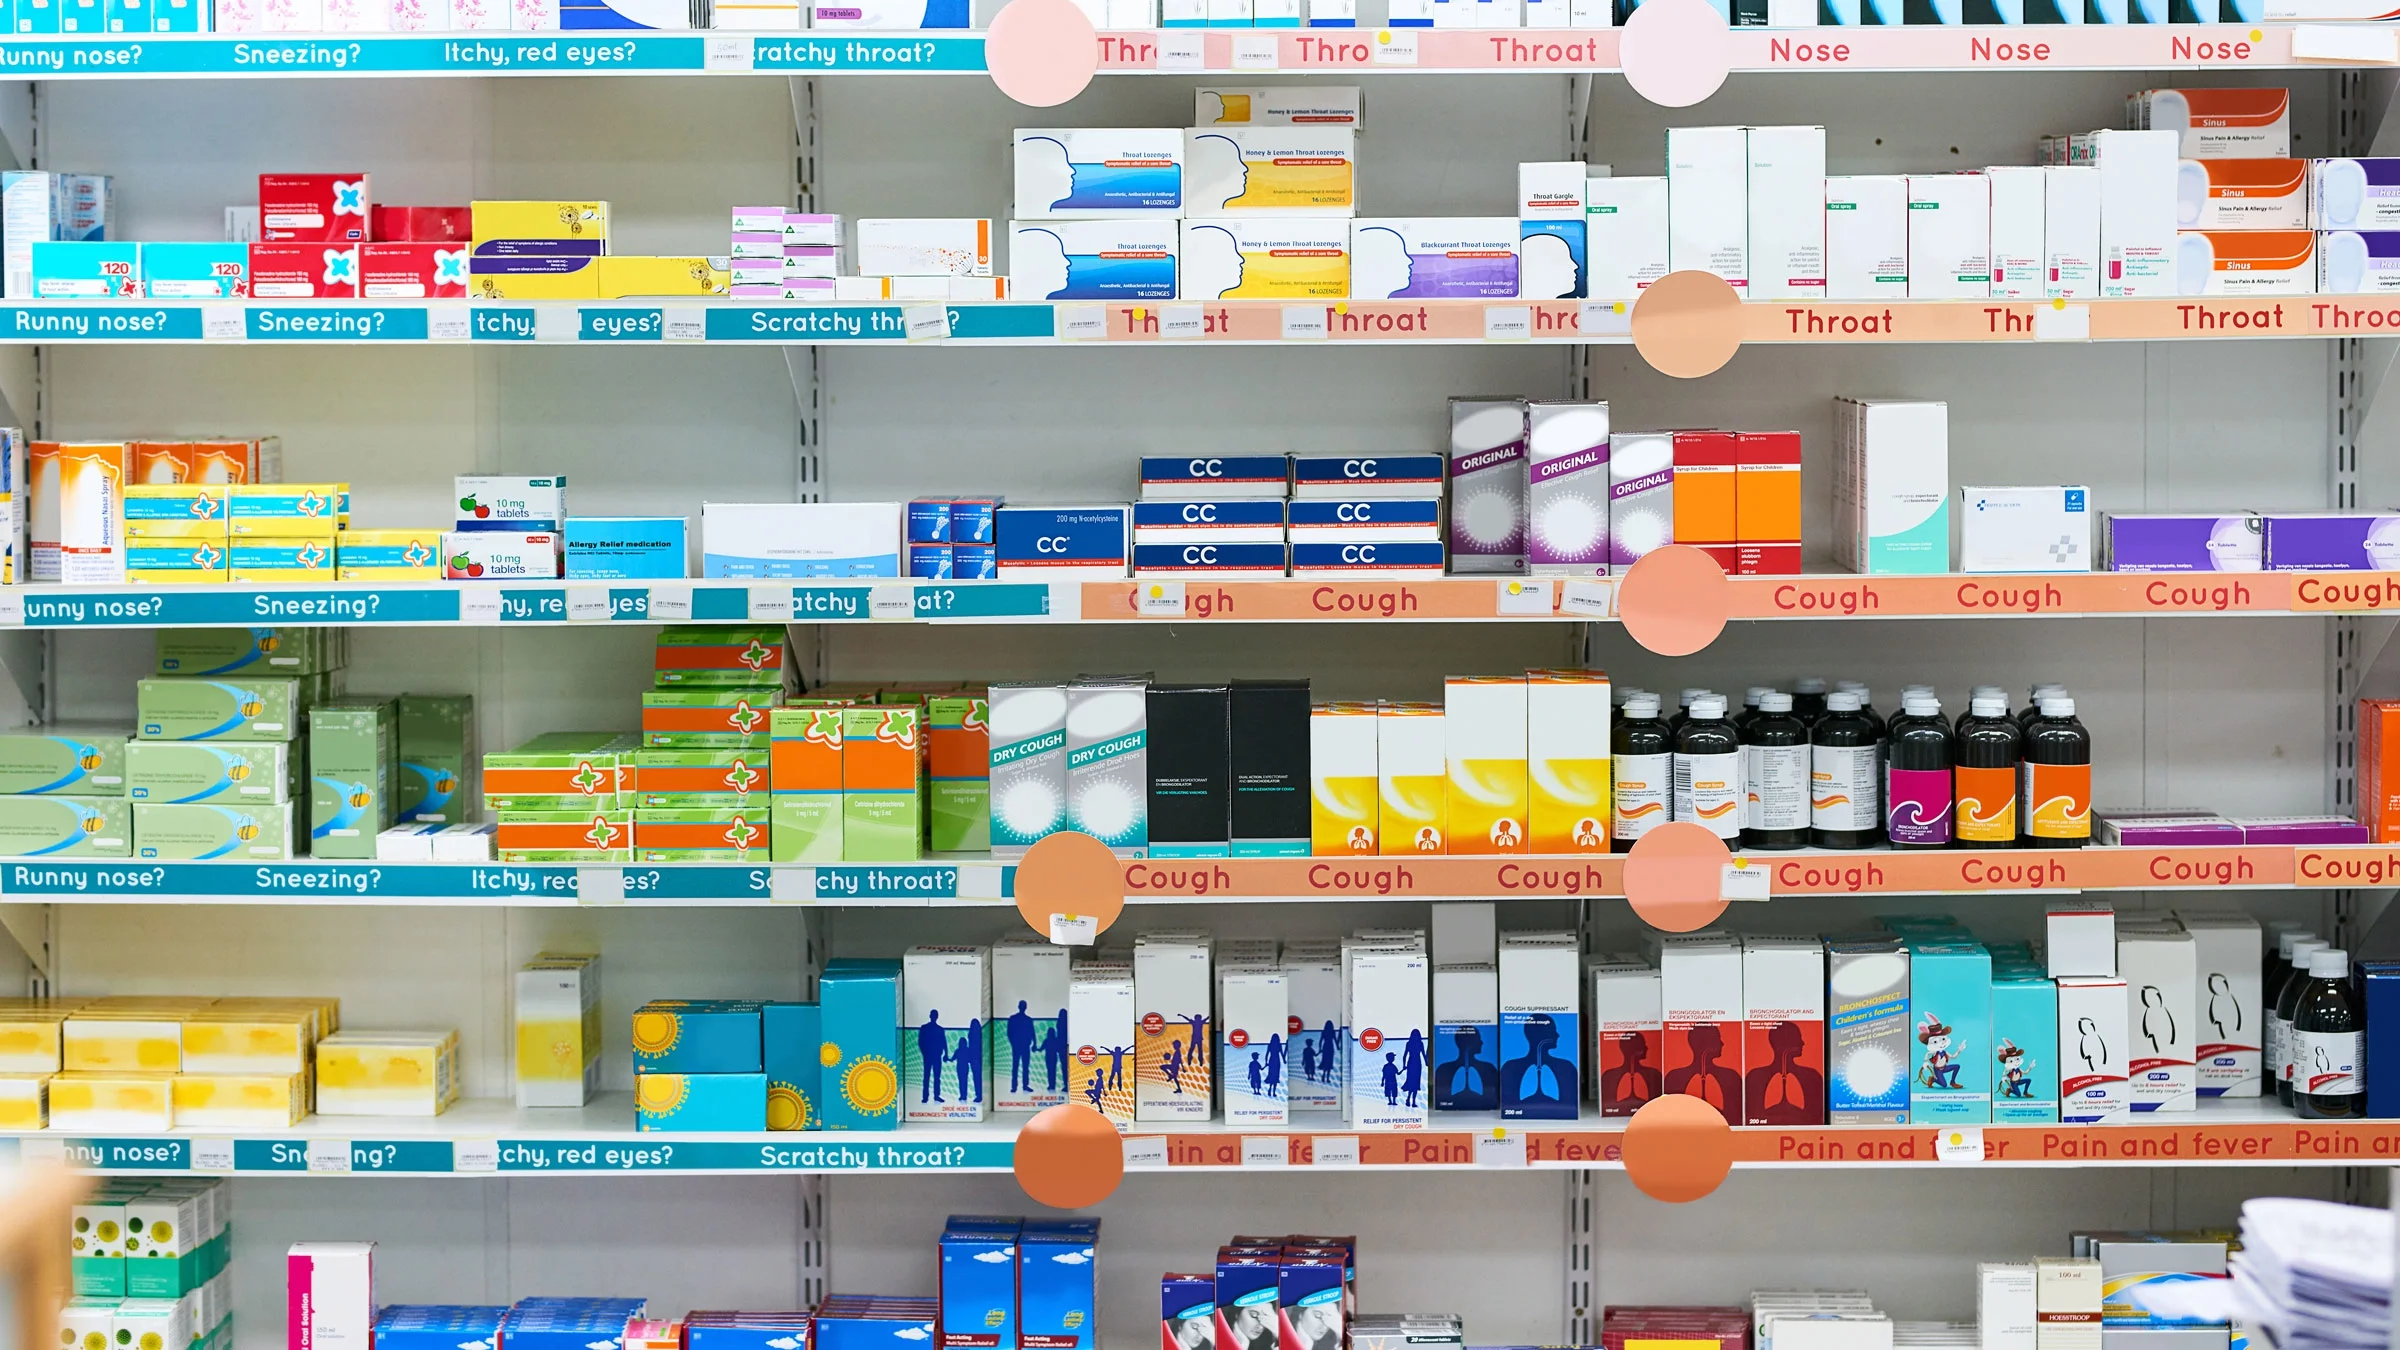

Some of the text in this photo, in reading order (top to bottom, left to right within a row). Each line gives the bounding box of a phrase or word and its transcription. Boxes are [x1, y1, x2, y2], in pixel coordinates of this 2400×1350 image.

[74, 45, 142, 64] nose?
[233, 43, 360, 67] Sneezing?
[446, 42, 636, 66] Itchy, red eyes?
[752, 42, 935, 65] ratchy throat?
[1296, 38, 1368, 61] Thro
[1490, 38, 1596, 61] Throat
[1772, 38, 1849, 61] Nose
[1972, 38, 2050, 60] Nose
[2173, 37, 2250, 59] Nose
[2203, 119, 2227, 127] Sinus
[2221, 189, 2245, 197] Sinus
[104, 262, 129, 275] 120
[216, 263, 240, 276] 120
[2226, 261, 2251, 270] Sinus
[16, 311, 166, 335] Runny nose?
[259, 311, 384, 336] Sneezing?
[478, 313, 535, 336] tchy,
[593, 313, 661, 336] eyes?
[752, 312, 860, 335] Scratchy
[1121, 309, 1228, 333] That
[1327, 307, 1427, 331] Throat
[1786, 309, 1892, 333] Throat
[2177, 304, 2283, 329] Throat
[2312, 305, 2400, 328] Throa
[1189, 459, 1223, 477] CC
[1343, 459, 1377, 478] CC
[1461, 447, 1517, 470] ORIGINAL
[1541, 451, 1599, 476] ORIGINAL
[101, 475, 110, 495] Spray
[1616, 473, 1668, 496] ORIGINAL
[496, 499, 525, 509] 10 mg
[496, 509, 530, 518] tablets
[1182, 504, 1216, 523] CC
[1337, 503, 1371, 522] CC
[102, 516, 110, 545] Aqueous
[1056, 515, 1068, 523] 200
[1079, 515, 1119, 524] N-acetylcysteine
[568, 541, 597, 549] Allergy
[1036, 536, 1067, 553] CC
[1183, 545, 1217, 565] CC
[1341, 545, 1376, 563] CC
[490, 555, 521, 564] 10 mg
[491, 565, 526, 574] tablets
[1313, 587, 1417, 616] Cough
[1775, 585, 1878, 614] Cough
[1958, 583, 2061, 612] Cough
[2146, 581, 2249, 610] Cough
[2298, 578, 2400, 607] Cough
[95, 597, 162, 616] nose?
[255, 594, 380, 619] Sneezing?
[993, 733, 1063, 763] DRY COUGH
[1071, 735, 1141, 765] DRY COUGH
[997, 750, 1060, 774] Irritating Dry Cough
[16, 867, 164, 890] Runny nose?
[257, 868, 381, 892] Sneezing?
[473, 869, 536, 891] Itchy,
[868, 870, 956, 890] throat?
[1126, 864, 1229, 894] Cough
[1309, 864, 1412, 894] Cough
[1498, 864, 1601, 894] Cough
[1780, 862, 1883, 891] Cough
[1962, 859, 2065, 888] Cough
[2150, 856, 2253, 884] Cough
[2301, 854, 2400, 883] Cough
[1839, 992, 1901, 1013] BRONCHOSPECT
[1835, 1003, 1904, 1026] Children's formula
[114, 1143, 180, 1161] nose?
[1405, 1139, 1468, 1164] Pain
[1555, 1139, 1621, 1162] feve
[1780, 1136, 1914, 1159] Pain and
[2044, 1132, 2272, 1157] Pain and fever
[2296, 1130, 2400, 1153] Pain an
[558, 1145, 595, 1163] red
[605, 1146, 673, 1168] eyes?
[761, 1146, 965, 1168] Scratchy throat?
[301, 1293, 309, 1346] Oral Solution
